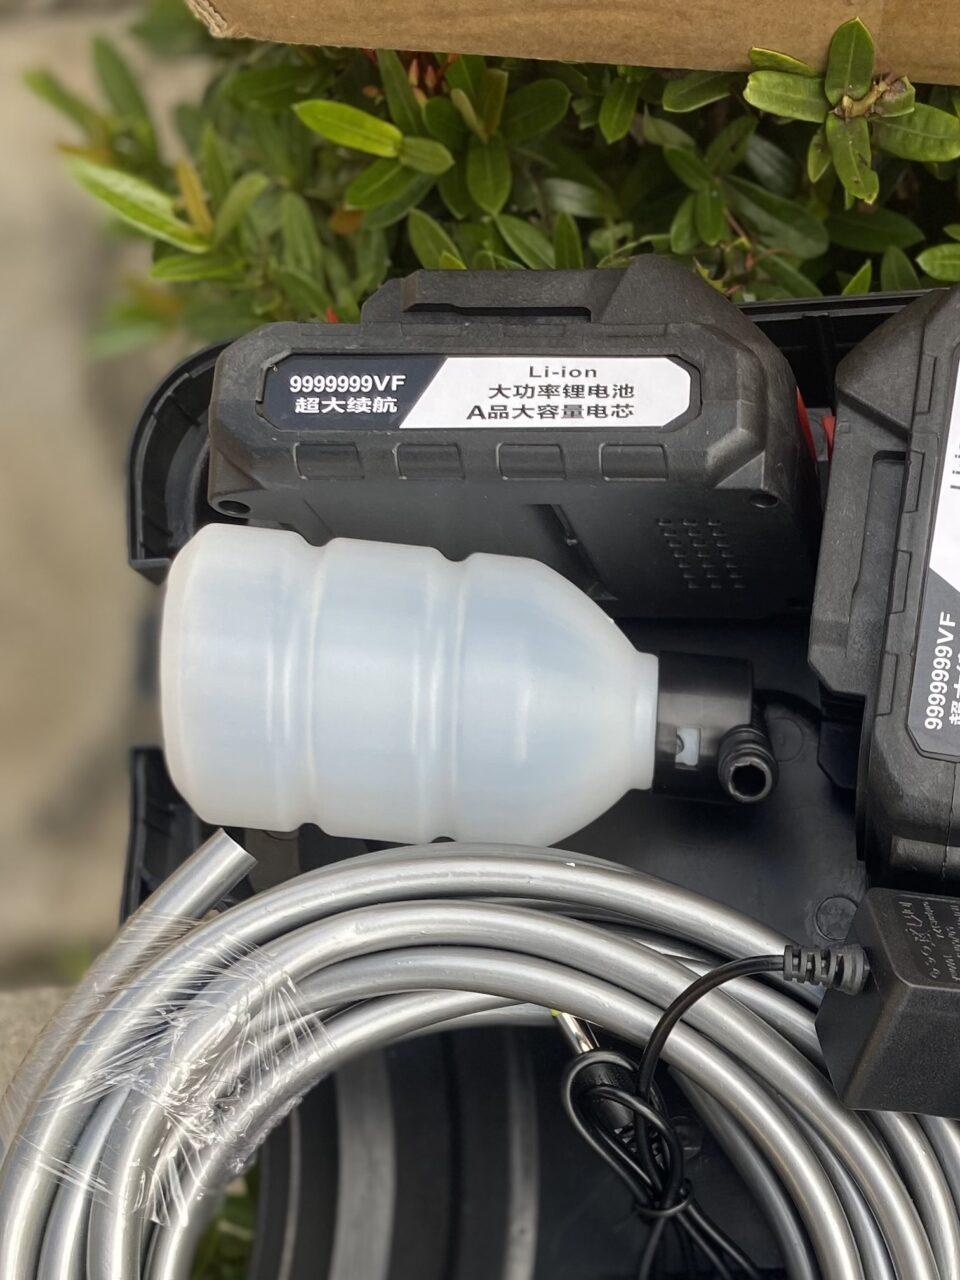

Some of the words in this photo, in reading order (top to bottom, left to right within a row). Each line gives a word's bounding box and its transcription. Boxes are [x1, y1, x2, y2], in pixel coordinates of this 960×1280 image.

[529, 364, 597, 379] Li-ion
[289, 375, 406, 393] 9999999VF
[488, 383, 635, 400] 大功率锂电池
[294, 397, 398, 415] 超大续航
[466, 403, 635, 421] A品大容量电芯
[925, 611, 957, 730] 9999999VF
